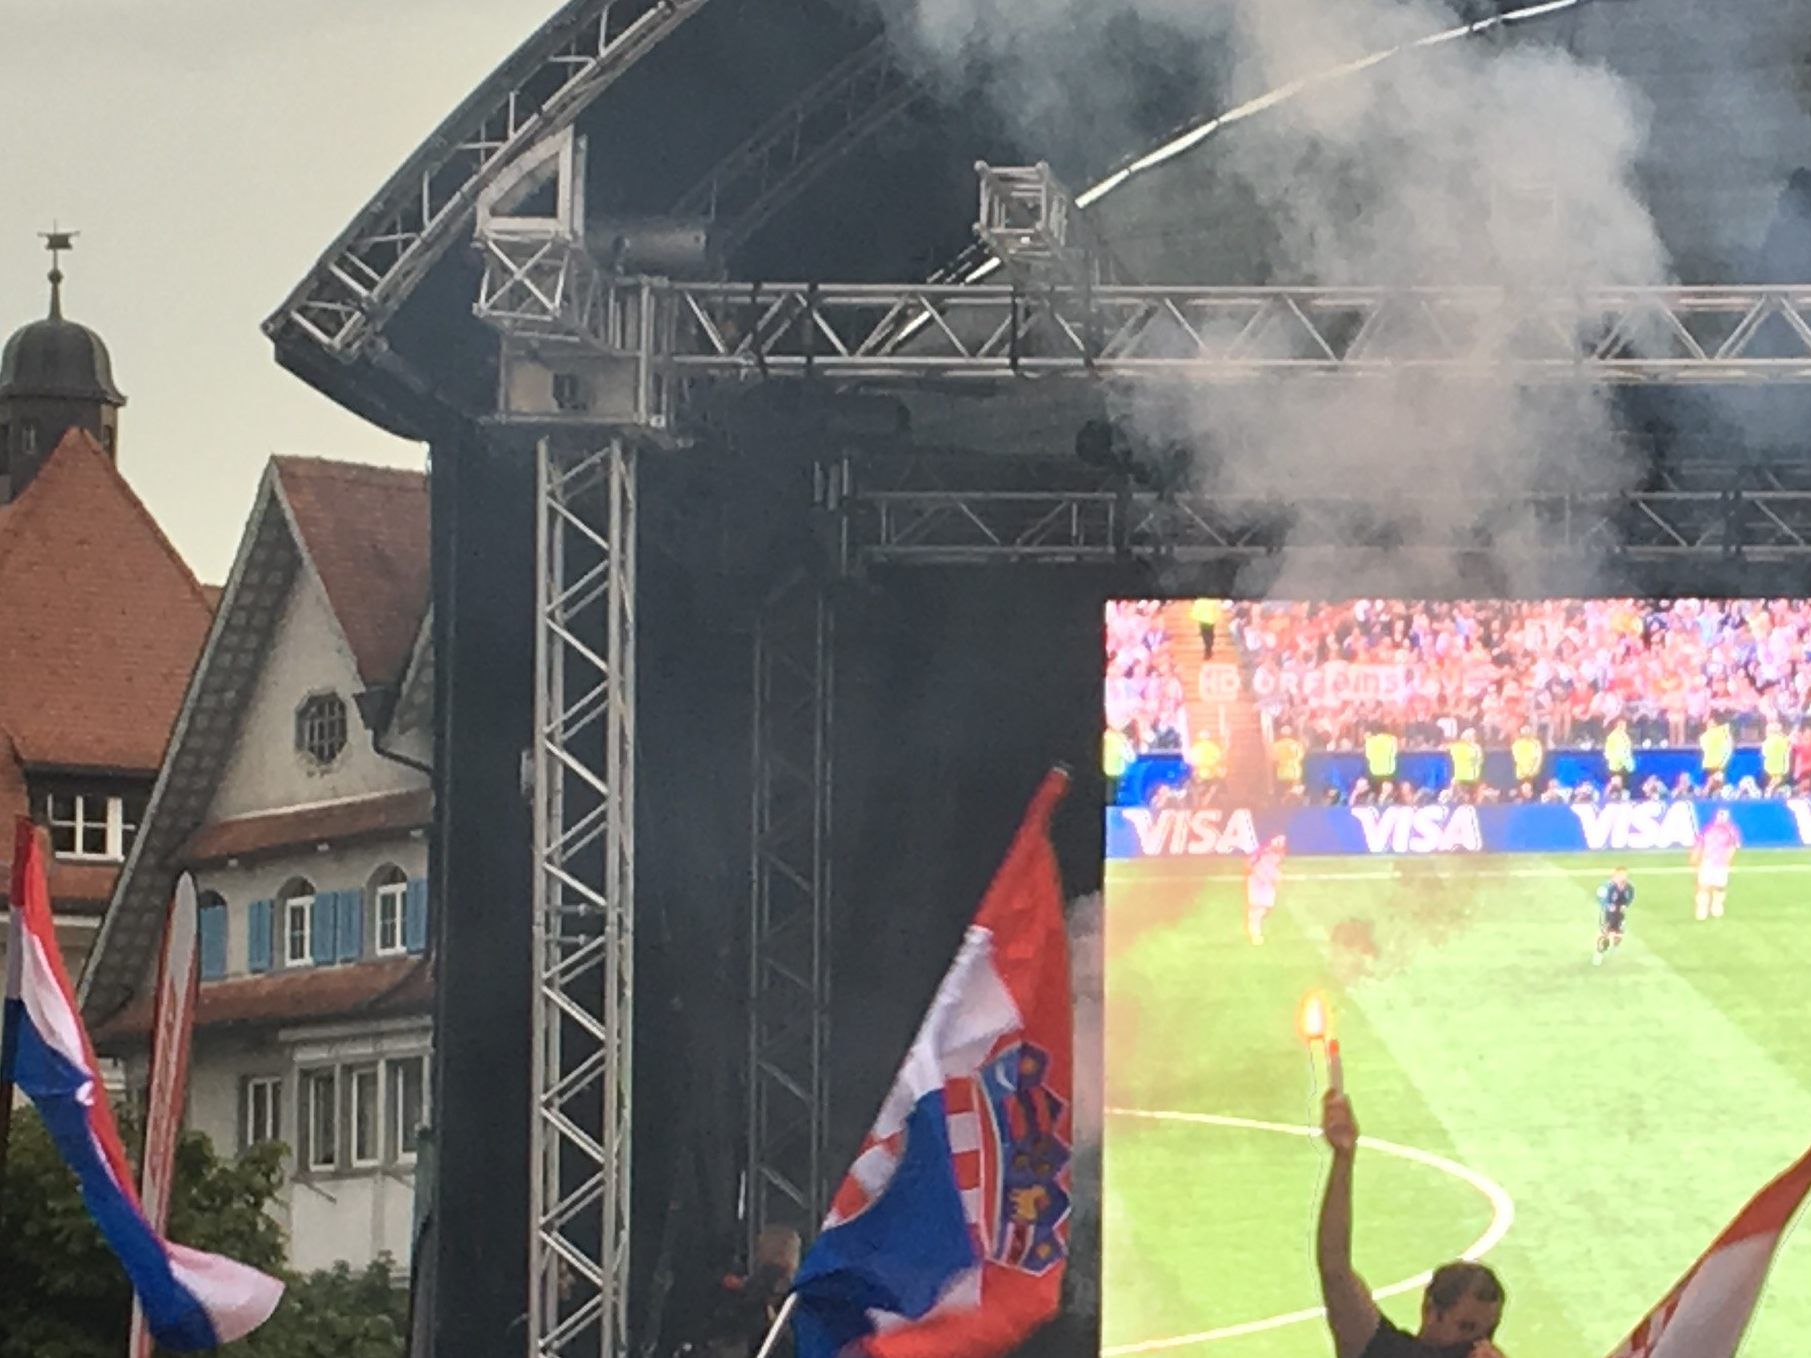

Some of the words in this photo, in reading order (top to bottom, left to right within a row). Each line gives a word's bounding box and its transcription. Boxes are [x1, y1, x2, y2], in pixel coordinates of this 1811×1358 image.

[1122, 808, 1259, 855] VISA
[1351, 804, 1482, 854] VISA
[1570, 799, 1699, 849] VISA
